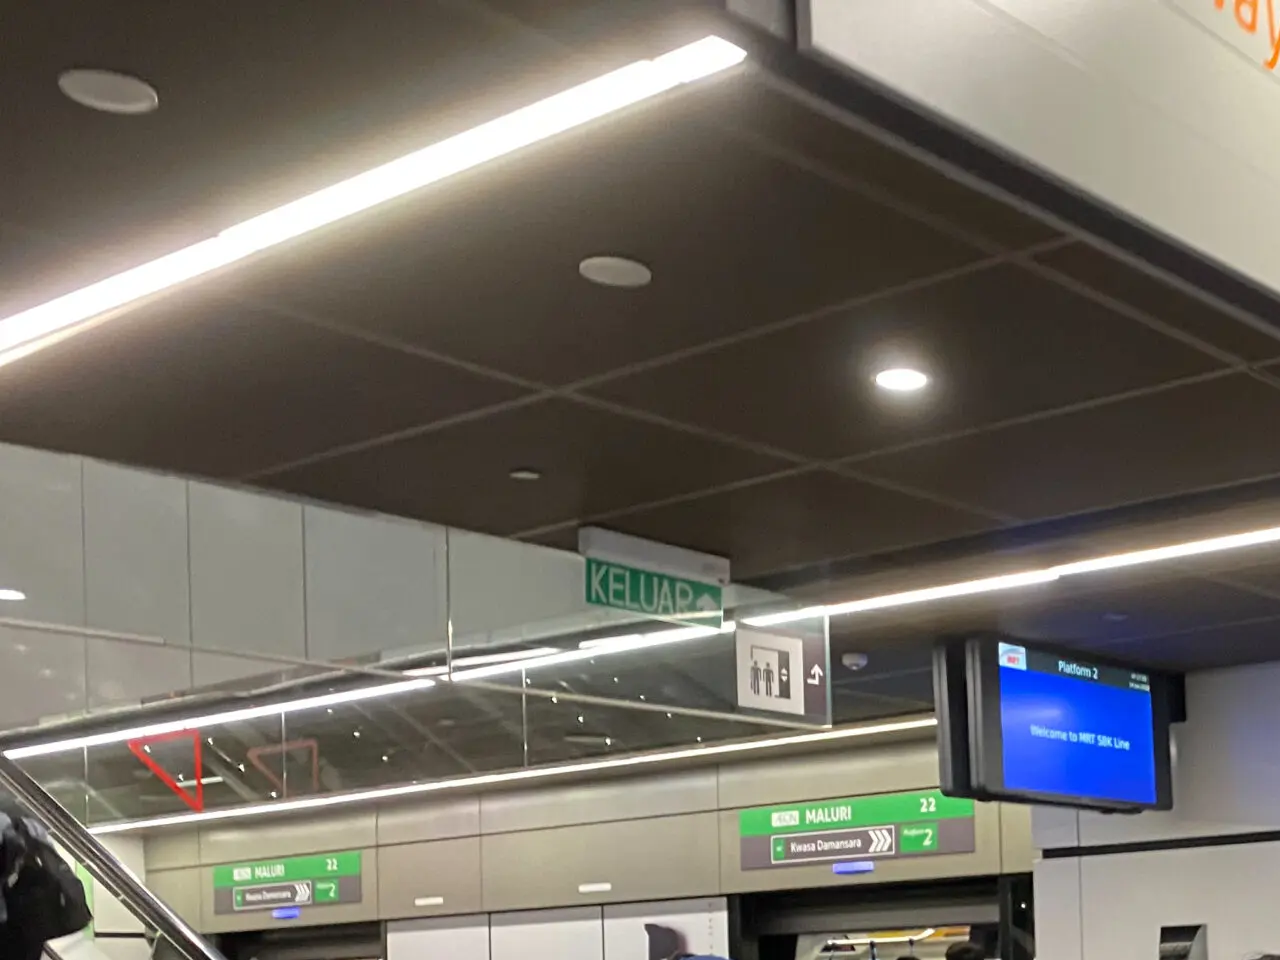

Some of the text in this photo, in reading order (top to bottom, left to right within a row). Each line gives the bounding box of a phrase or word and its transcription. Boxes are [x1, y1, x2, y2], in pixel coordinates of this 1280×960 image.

[590, 561, 693, 614] KELUAR
[1058, 660, 1099, 680] Platform 2
[1030, 724, 1130, 750] Welcome to MRT SBK Line
[805, 797, 937, 825] MALURI 22
[790, 840, 816, 853] Kwasa
[817, 837, 862, 851] Damansara
[922, 828, 933, 846] 2
[254, 863, 285, 879] MALURI
[326, 858, 338, 872] 22
